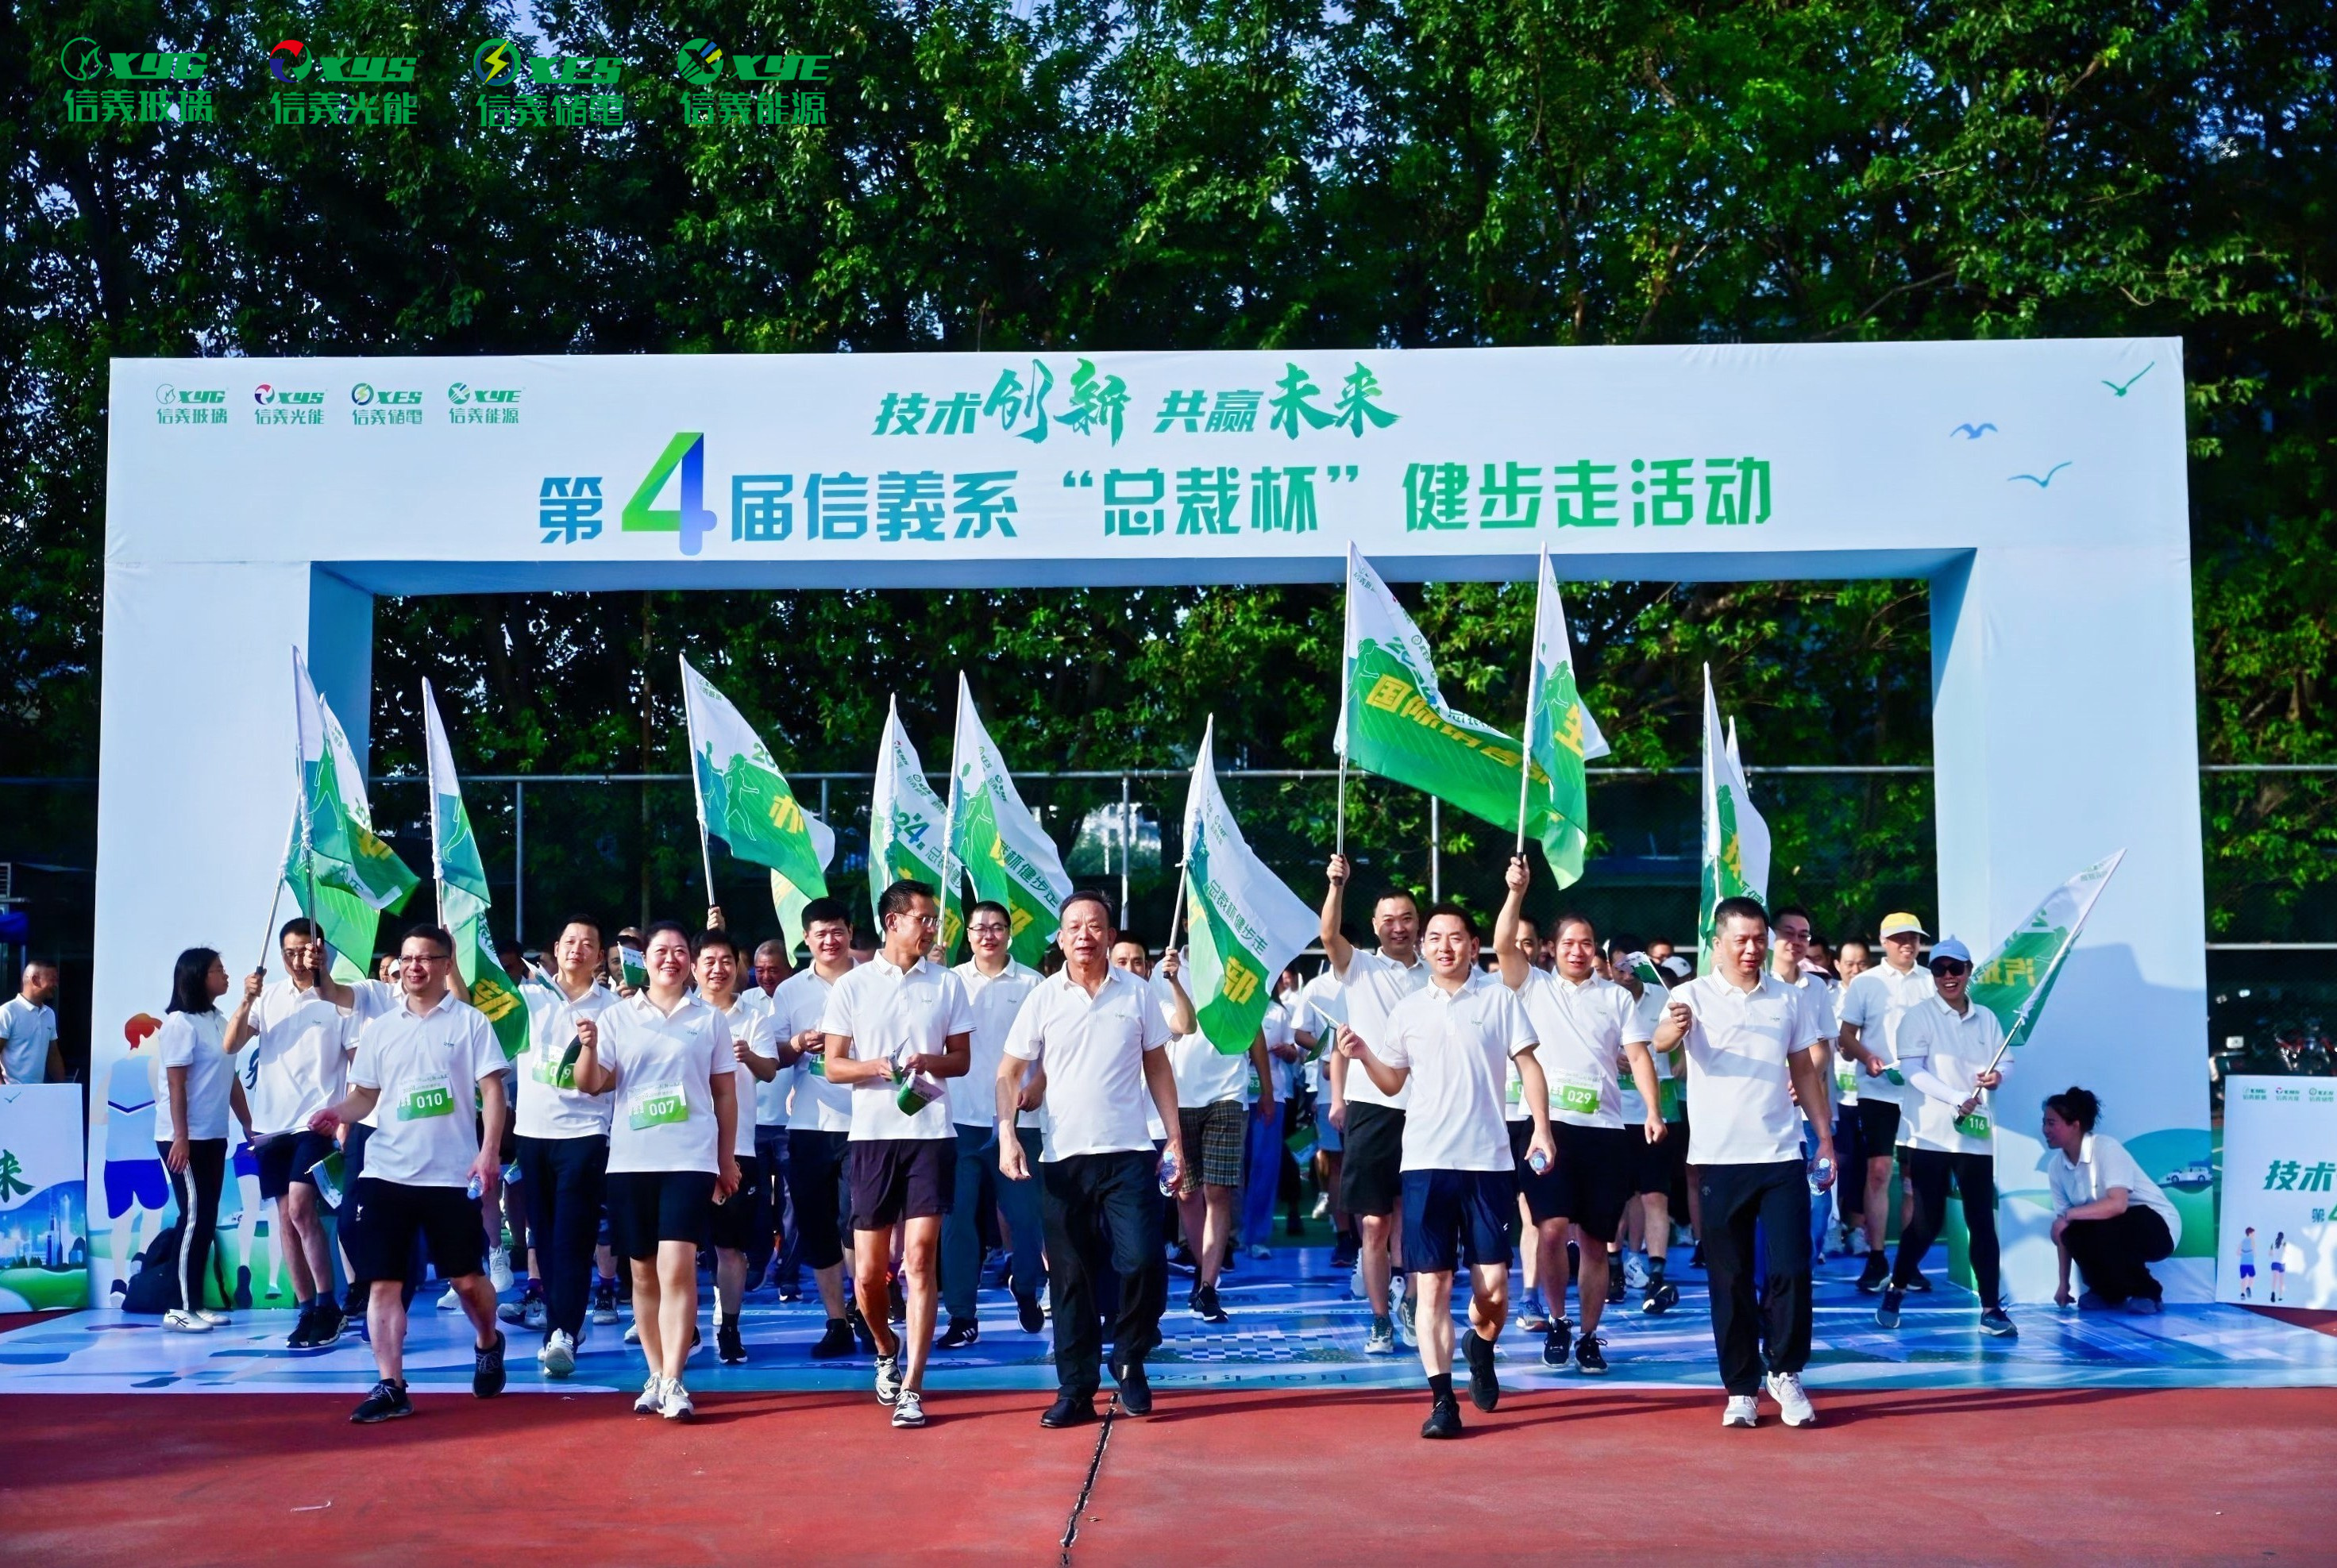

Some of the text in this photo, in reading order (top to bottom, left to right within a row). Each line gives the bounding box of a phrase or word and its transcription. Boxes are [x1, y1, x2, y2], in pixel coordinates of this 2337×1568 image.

[179, 391, 226, 403] XYG
[279, 391, 325, 404] XYS
[376, 391, 423, 404] XES
[474, 390, 521, 403] XYE
[156, 408, 228, 424] 信義玻璃
[255, 409, 324, 425] 信義光能
[449, 407, 519, 424] 信義能源
[417, 1093, 443, 1108] 010
[1567, 1090, 1592, 1104] 029
[649, 1100, 675, 1116] 007
[1969, 1117, 1985, 1131] 116
